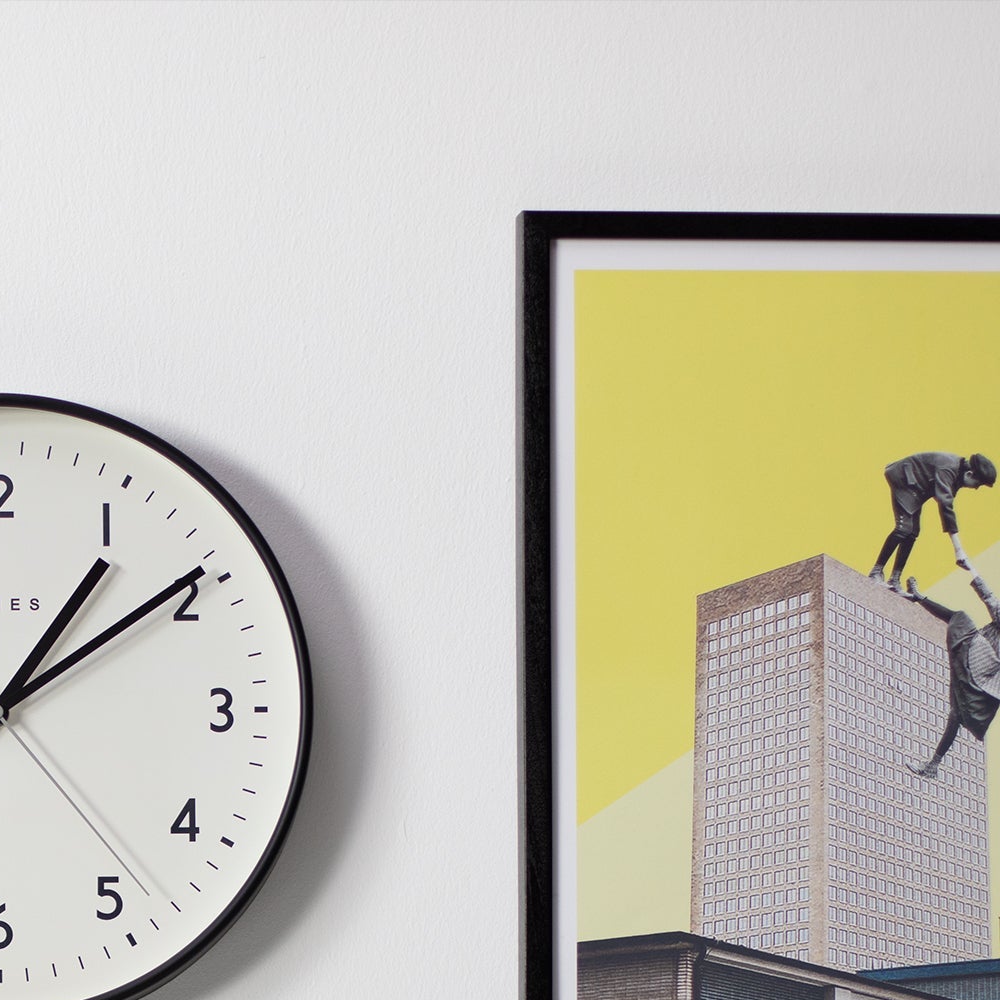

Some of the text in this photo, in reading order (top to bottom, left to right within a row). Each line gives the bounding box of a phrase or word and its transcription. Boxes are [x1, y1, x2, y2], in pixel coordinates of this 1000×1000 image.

[101, 503, 111, 547] 1
[173, 577, 200, 622] 2
[210, 688, 235, 733] 3
[169, 798, 201, 842] 4
[96, 876, 123, 921] 5
